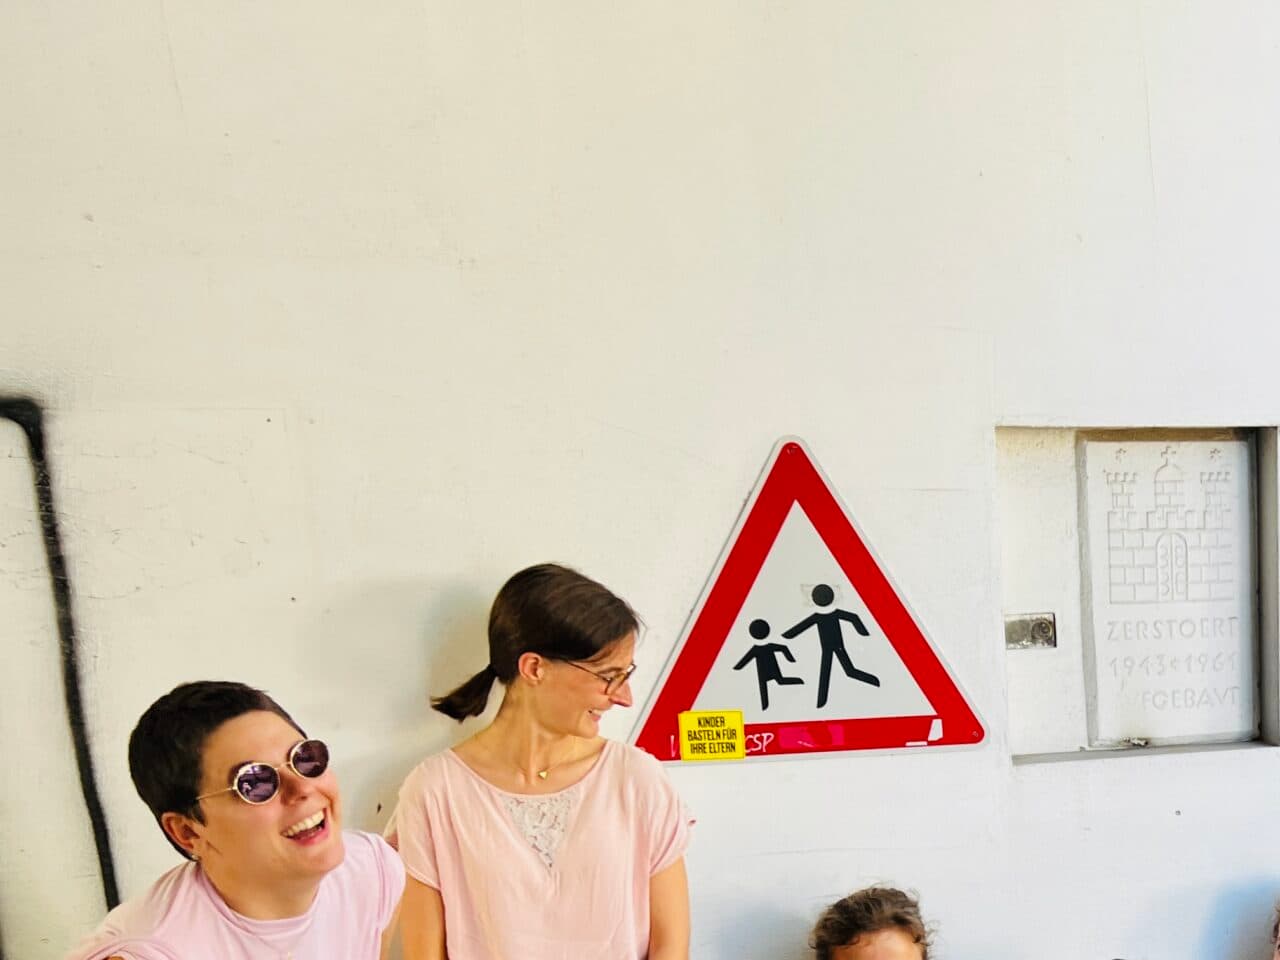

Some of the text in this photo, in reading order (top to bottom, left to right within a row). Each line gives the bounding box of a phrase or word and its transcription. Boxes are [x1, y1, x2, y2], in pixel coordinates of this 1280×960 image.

[1106, 615, 1239, 641] ZERSTOERT
[697, 716, 725, 727] KINDER
[687, 727, 737, 742] BASTELN FÜR
[690, 742, 707, 754] IHRE
[709, 741, 736, 753] ELTERN
